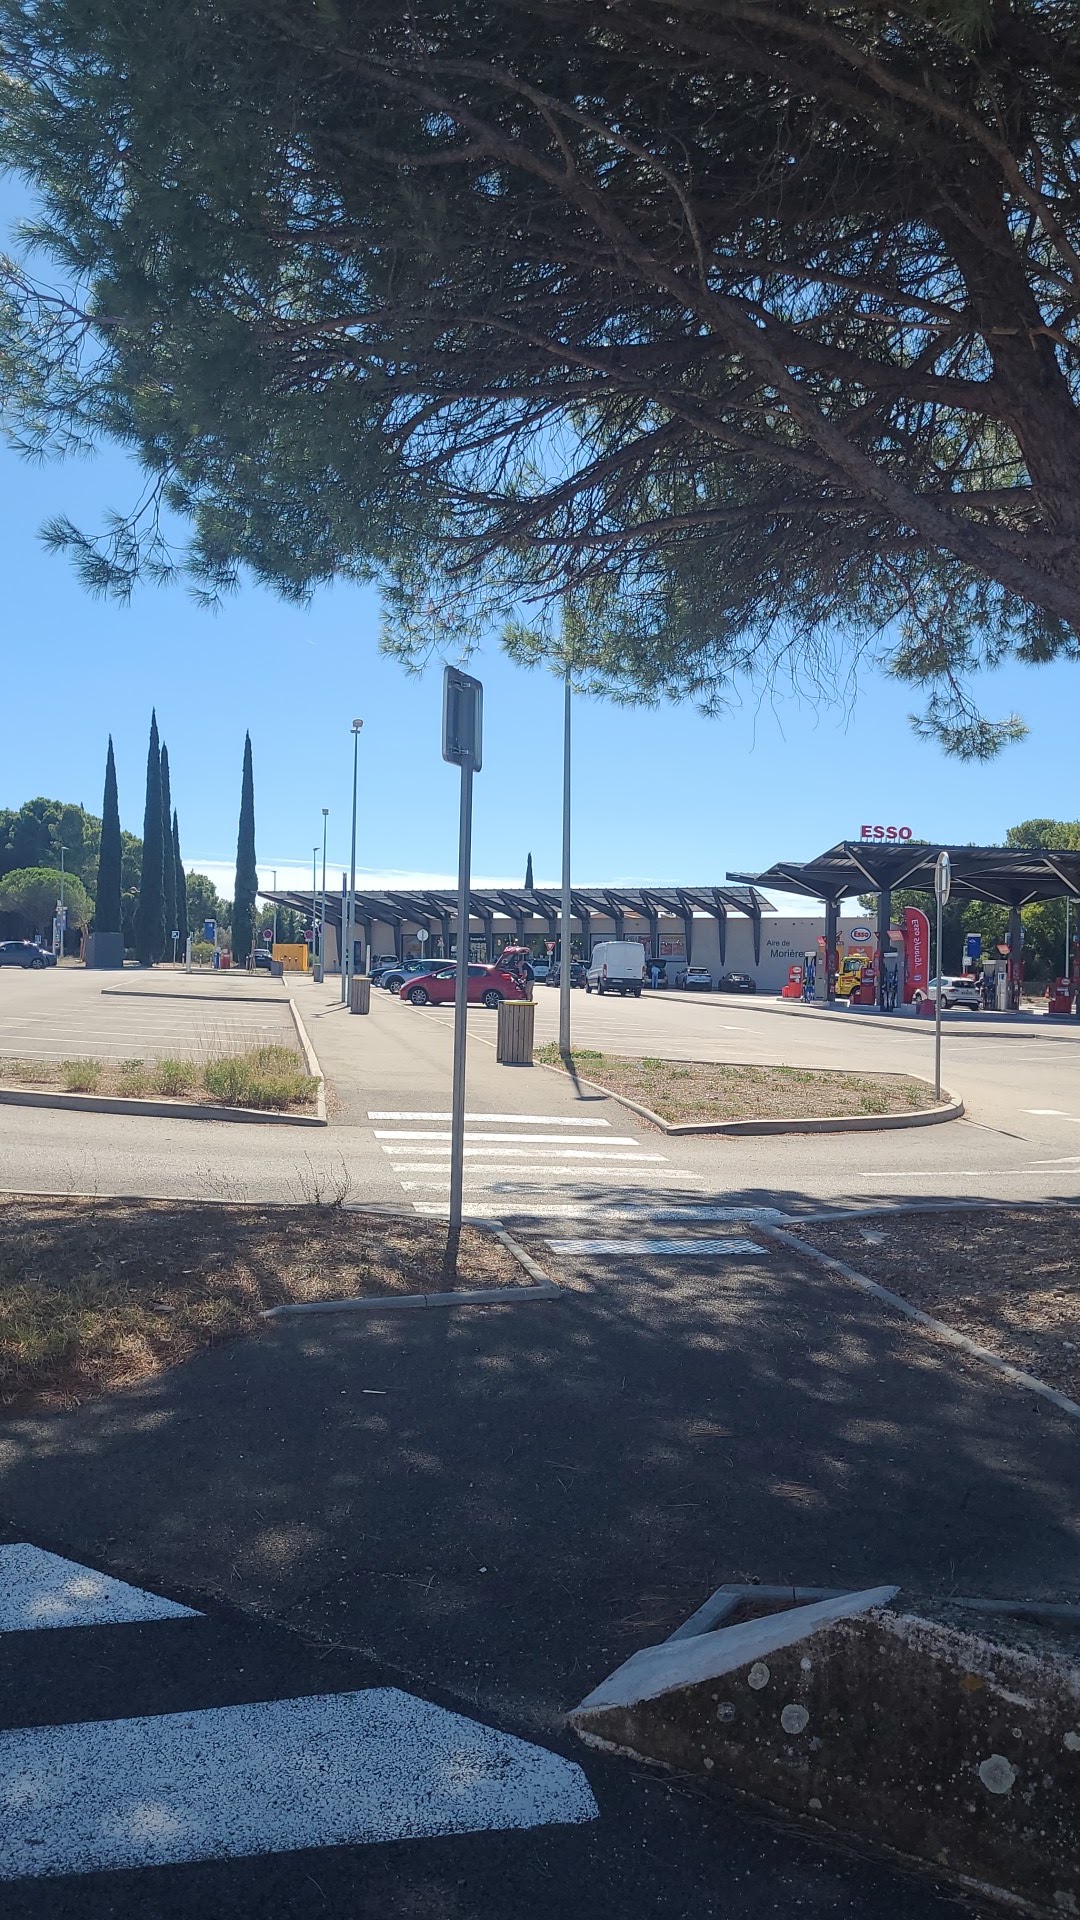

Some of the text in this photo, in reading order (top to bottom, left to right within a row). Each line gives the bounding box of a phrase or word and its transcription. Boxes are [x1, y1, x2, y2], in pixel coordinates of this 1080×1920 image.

[861, 825, 912, 839] ESSO
[853, 930, 869, 938] Esso
[766, 939, 791, 947] Aire de
[770, 948, 806, 958] Morière
